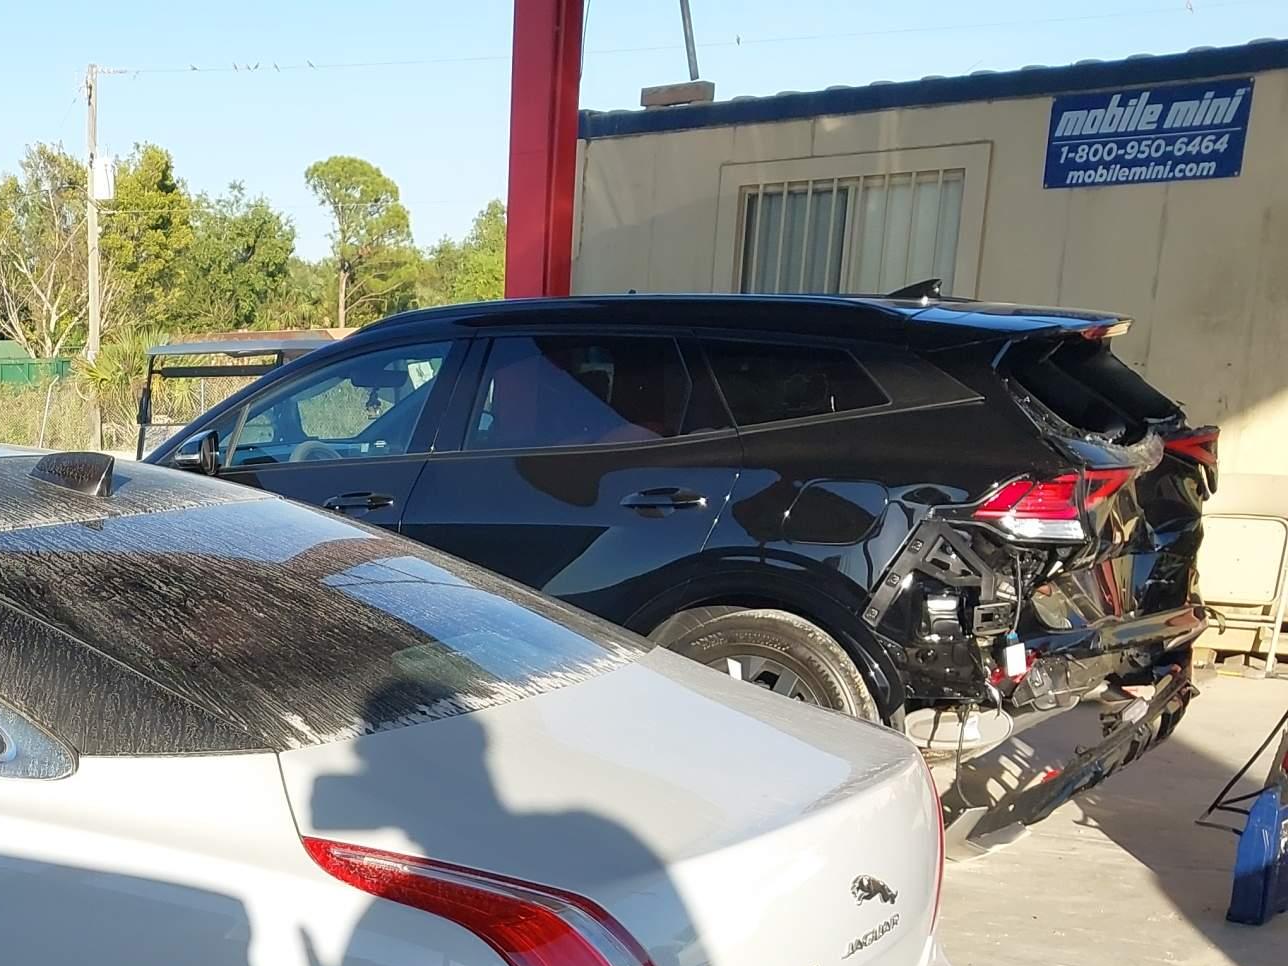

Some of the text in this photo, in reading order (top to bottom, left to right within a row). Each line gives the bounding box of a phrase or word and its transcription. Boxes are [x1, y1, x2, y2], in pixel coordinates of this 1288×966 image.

[1054, 88, 1246, 137] mobile mini
[1059, 134, 1229, 164] 1-800-950-6464
[1066, 160, 1216, 184] mobilemini.com
[840, 913, 900, 960] JAGUAR
